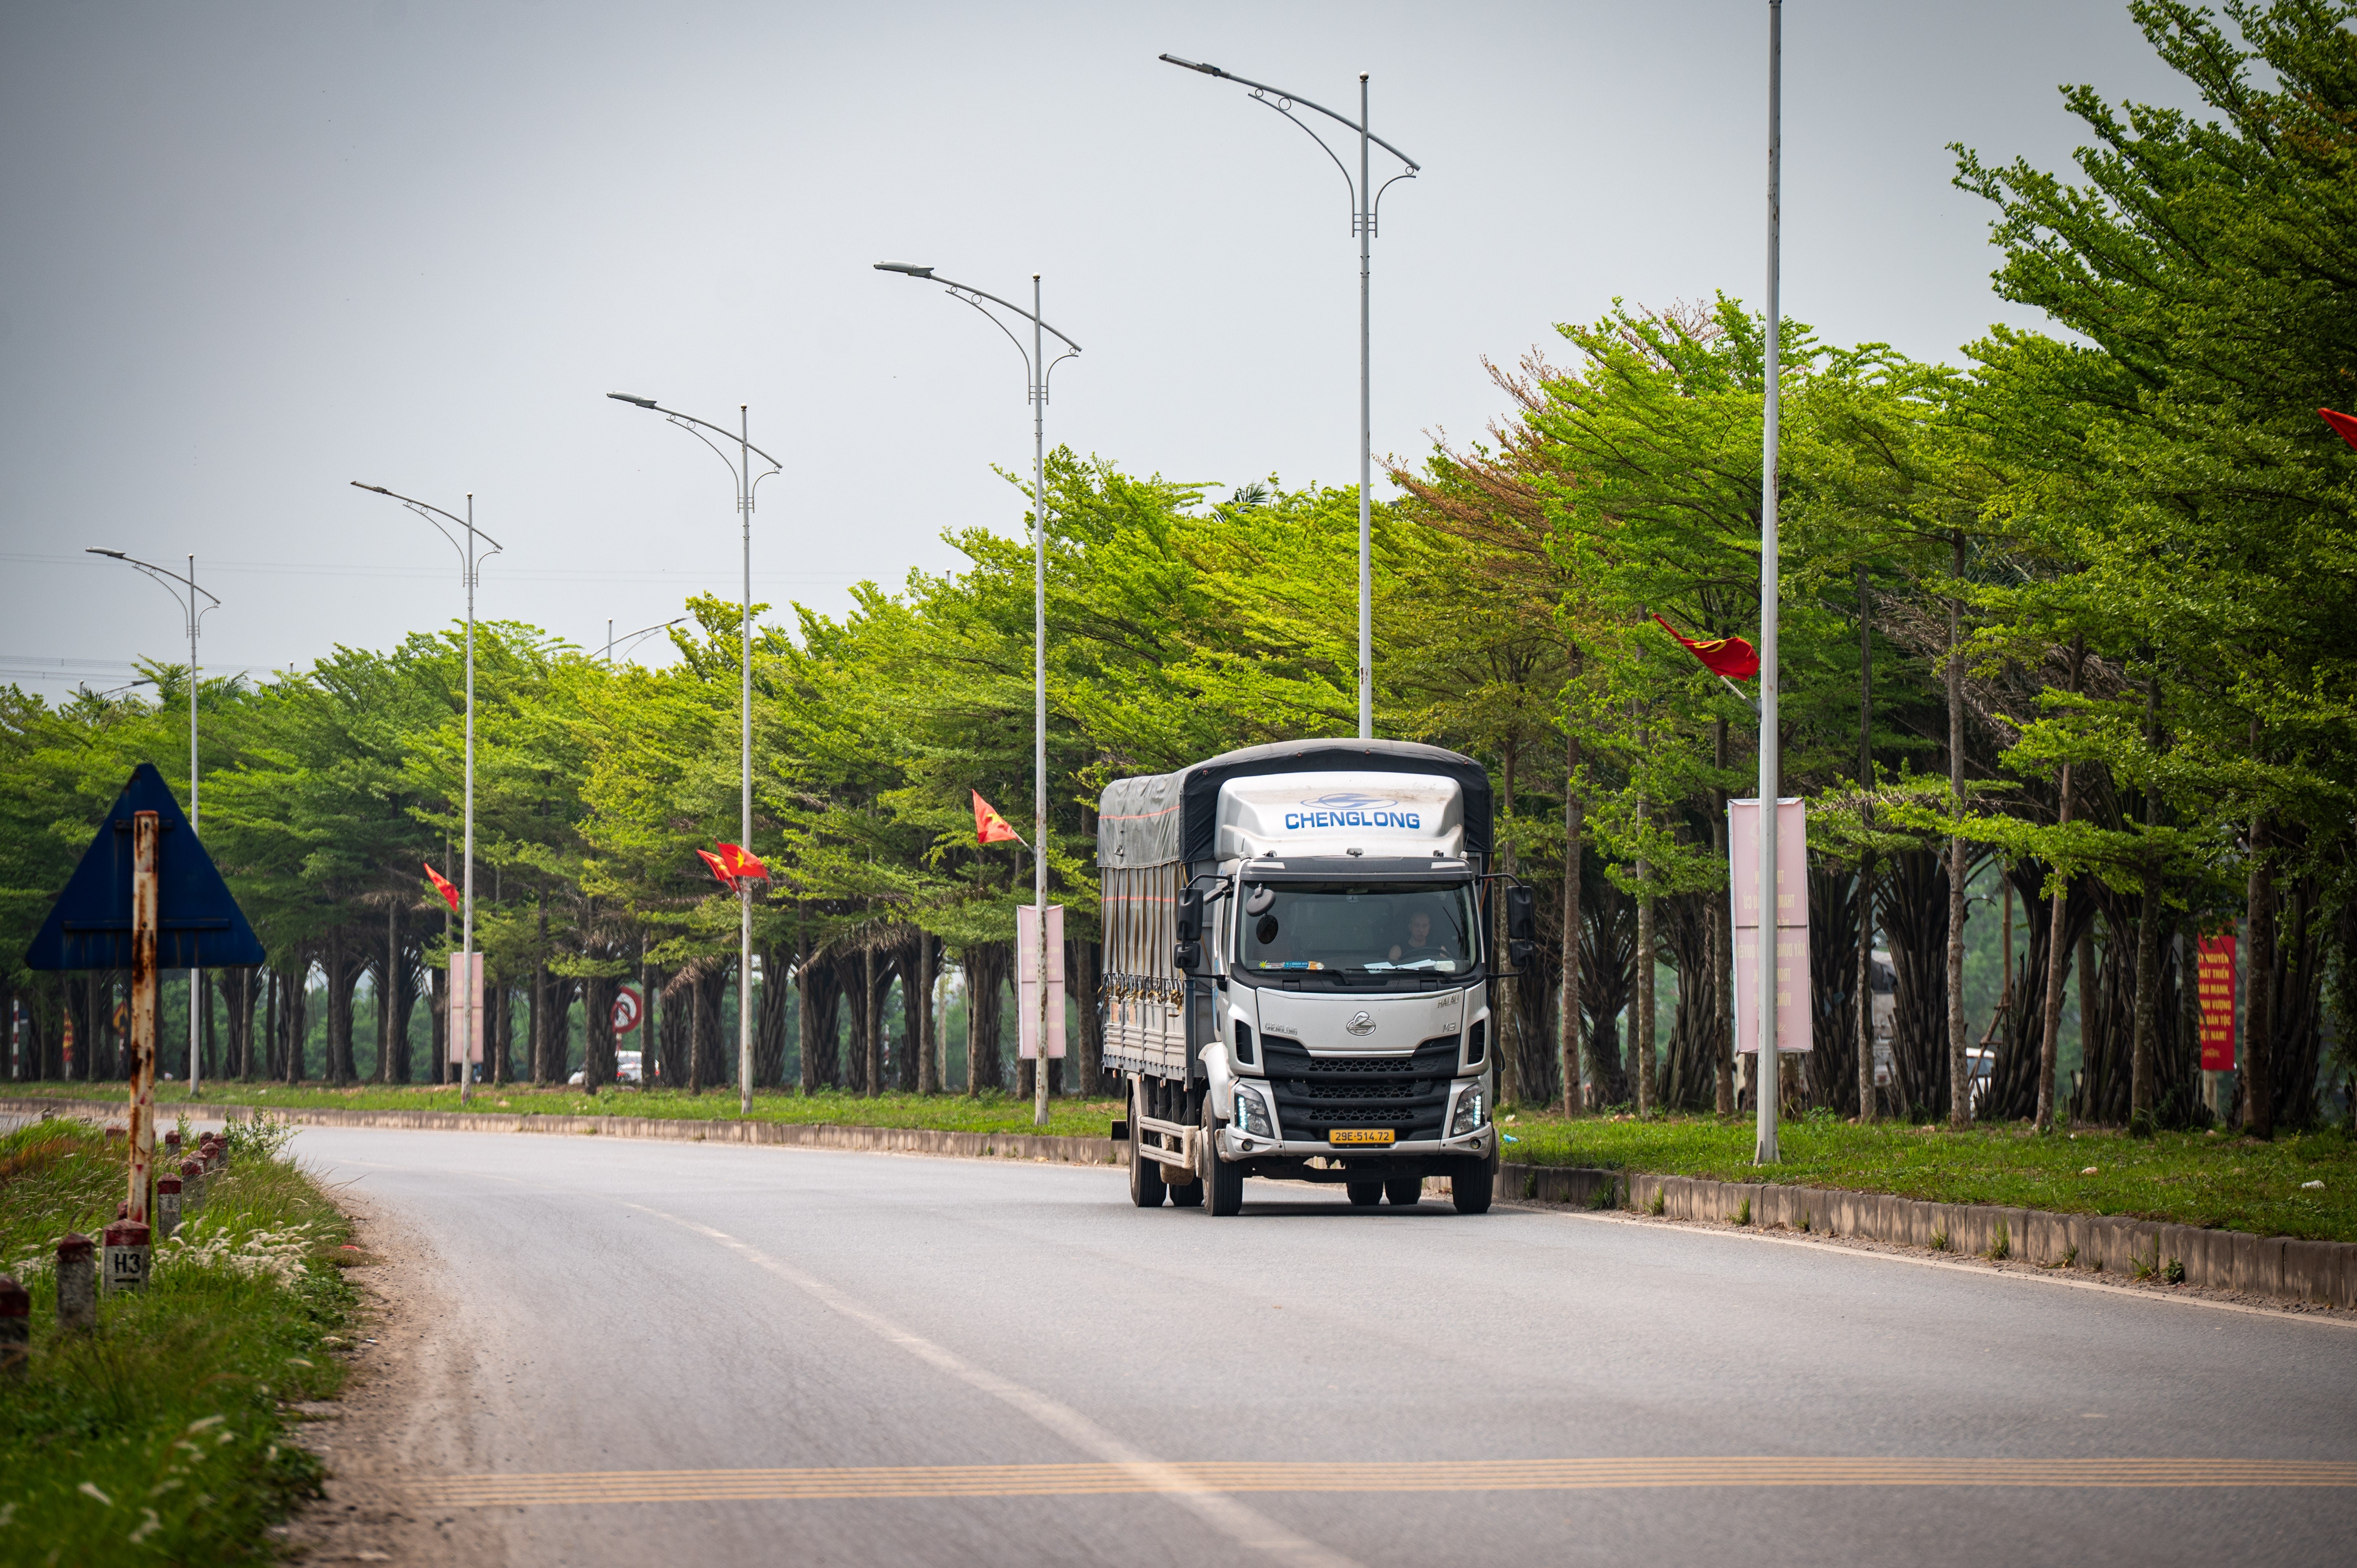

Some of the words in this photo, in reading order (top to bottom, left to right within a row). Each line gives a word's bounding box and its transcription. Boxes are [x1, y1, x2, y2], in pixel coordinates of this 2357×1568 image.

[1285, 811, 1420, 829] CHENGLONG
[1265, 1022, 1298, 1035] CHENGLONG
[1443, 1022, 1456, 1033] M3
[2211, 1030, 2226, 1042] NAM!
[1335, 1132, 1389, 1141] 29E-514.72
[115, 1253, 141, 1273] H3
